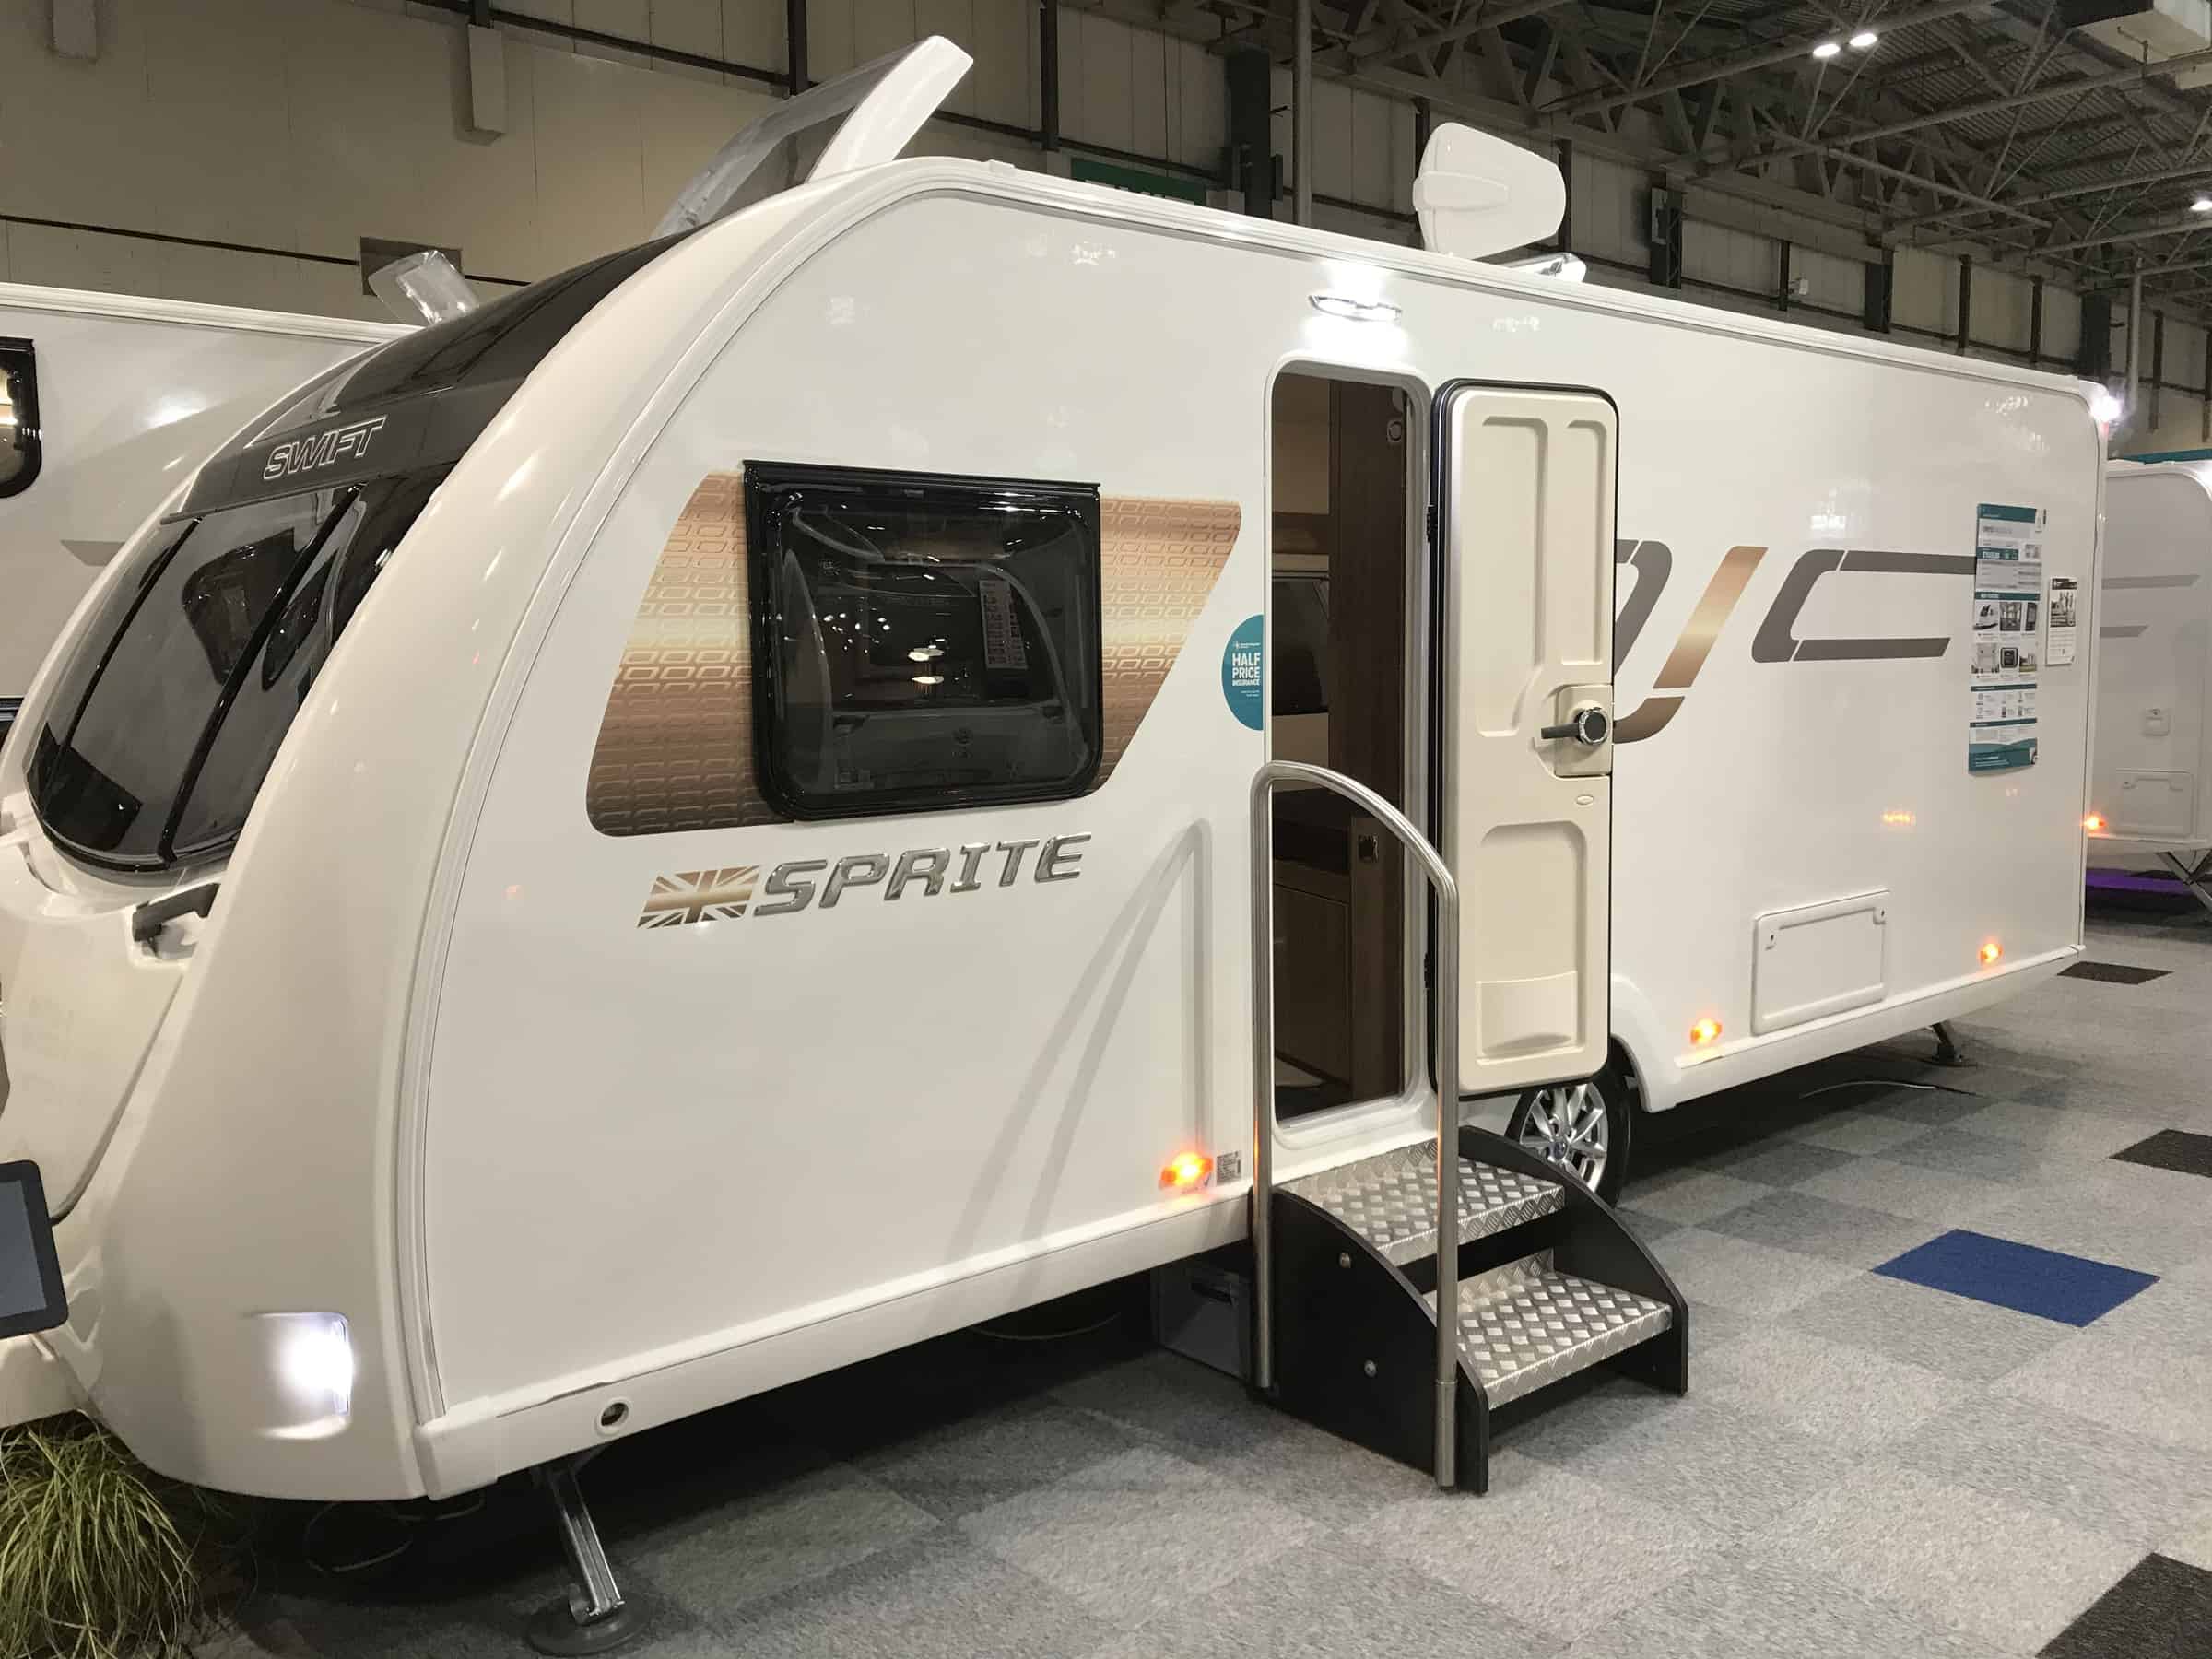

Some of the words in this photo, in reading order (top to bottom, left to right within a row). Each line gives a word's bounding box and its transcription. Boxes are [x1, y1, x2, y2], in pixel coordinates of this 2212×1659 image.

[263, 416, 386, 480] SWIFT
[1232, 653, 1261, 666] HALF
[1232, 666, 1260, 679] PRICE
[753, 831, 1092, 917] SPRITE
